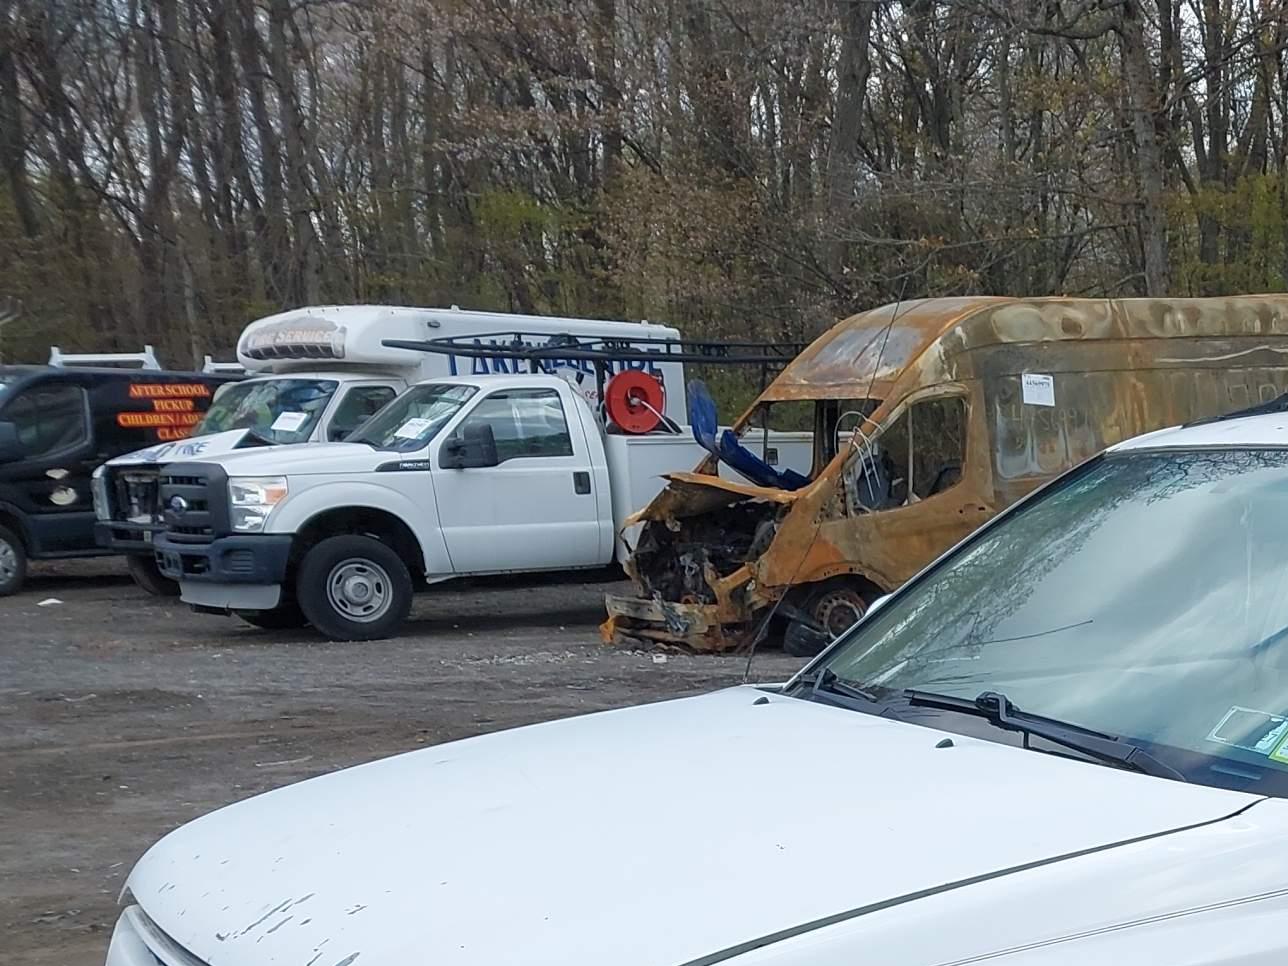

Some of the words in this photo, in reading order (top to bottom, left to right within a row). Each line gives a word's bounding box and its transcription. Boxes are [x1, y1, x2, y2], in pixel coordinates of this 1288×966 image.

[130, 384, 162, 397] AFTER
[165, 384, 209, 397] SCHOOL
[154, 399, 194, 411] PICKUP
[118, 412, 175, 426] CHILDREN
